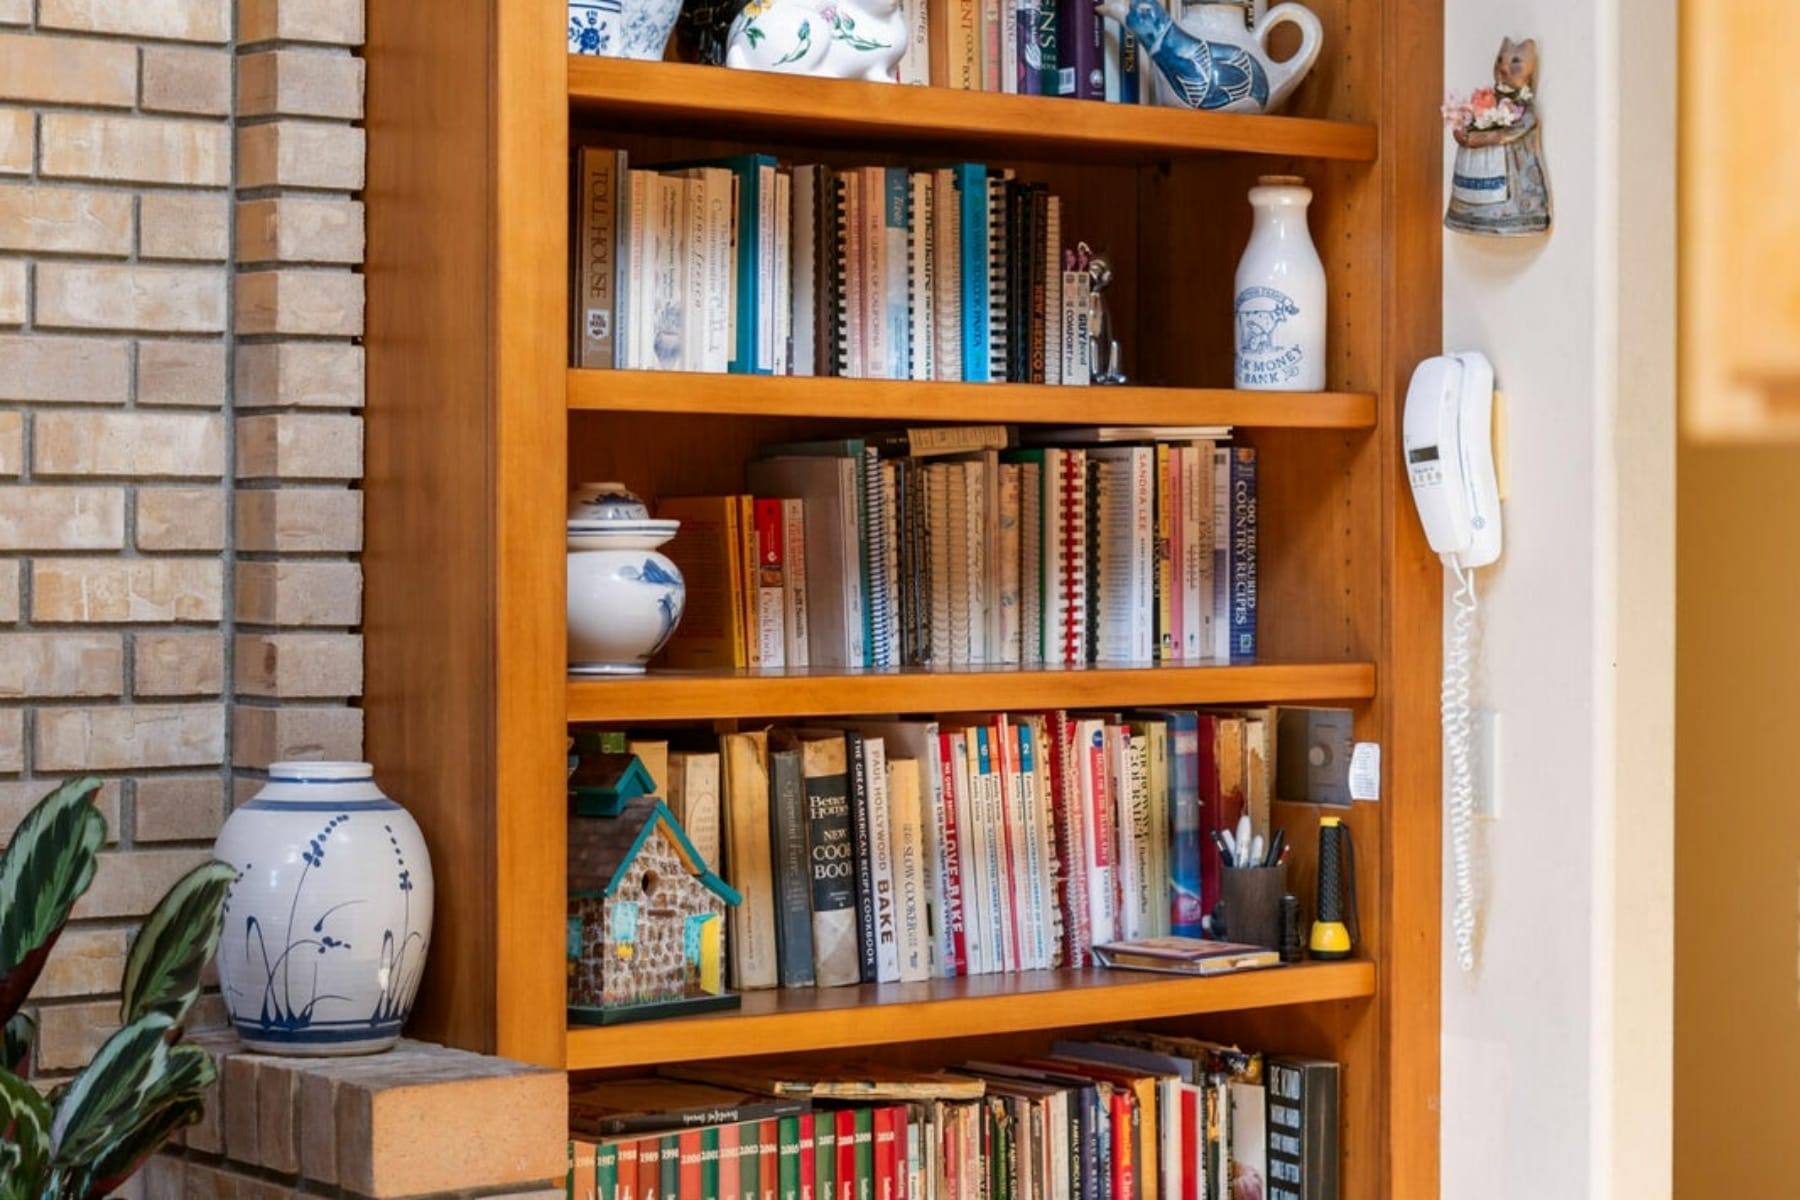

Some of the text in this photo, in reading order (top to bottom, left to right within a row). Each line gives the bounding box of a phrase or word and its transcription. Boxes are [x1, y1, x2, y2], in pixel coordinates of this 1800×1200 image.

[591, 168, 609, 224] TOLL
[591, 227, 609, 299] HOUSE
[1066, 310, 1077, 355] COMFORT
[1078, 313, 1088, 340] GUY
[1253, 344, 1303, 373] MONEY
[1244, 372, 1279, 385] BANK
[1138, 453, 1147, 532] SANDRA LEE
[1235, 480, 1248, 625] COUNTRY RECIPES
[1246, 497, 1257, 608] 500 TREASURED
[1022, 743, 1030, 755] 2
[871, 750, 887, 871] PAUL HOLLYWOOD
[854, 739, 875, 966] THE GREAT AMERICAN RECIPE COOKBOOK
[877, 878, 894, 945] BAKE
[1072, 1119, 1081, 1189] FAMILY CIRCLE
